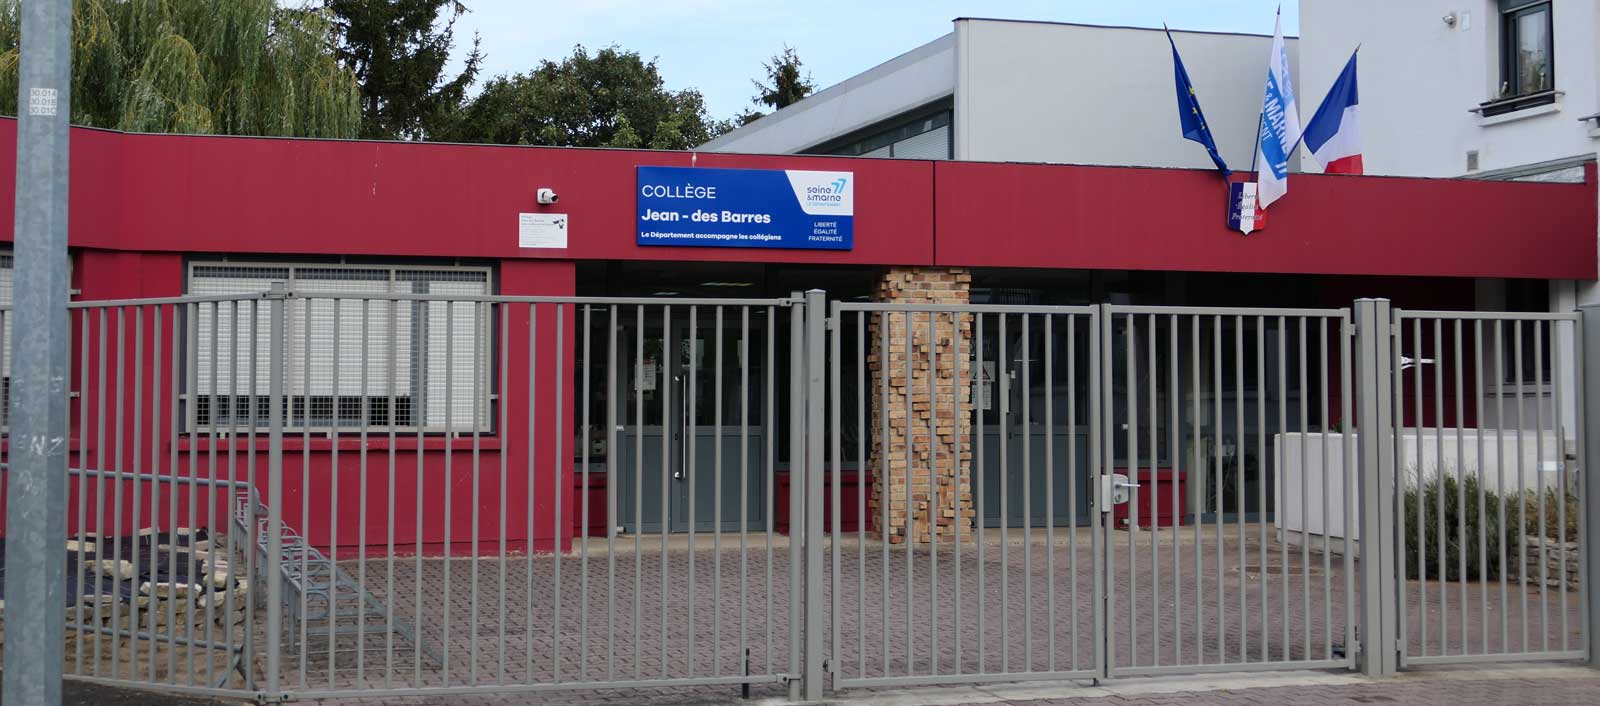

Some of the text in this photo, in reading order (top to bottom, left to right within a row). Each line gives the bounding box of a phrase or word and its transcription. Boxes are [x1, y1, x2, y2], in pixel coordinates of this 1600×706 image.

[641, 183, 717, 199] COLLÈGE
[807, 185, 831, 194] seine
[641, 208, 679, 221] Jean
[691, 209, 718, 222] des
[721, 211, 771, 224] Barres
[650, 231, 695, 239] Département
[695, 233, 738, 241] accompagne
[749, 233, 781, 242] collégiens
